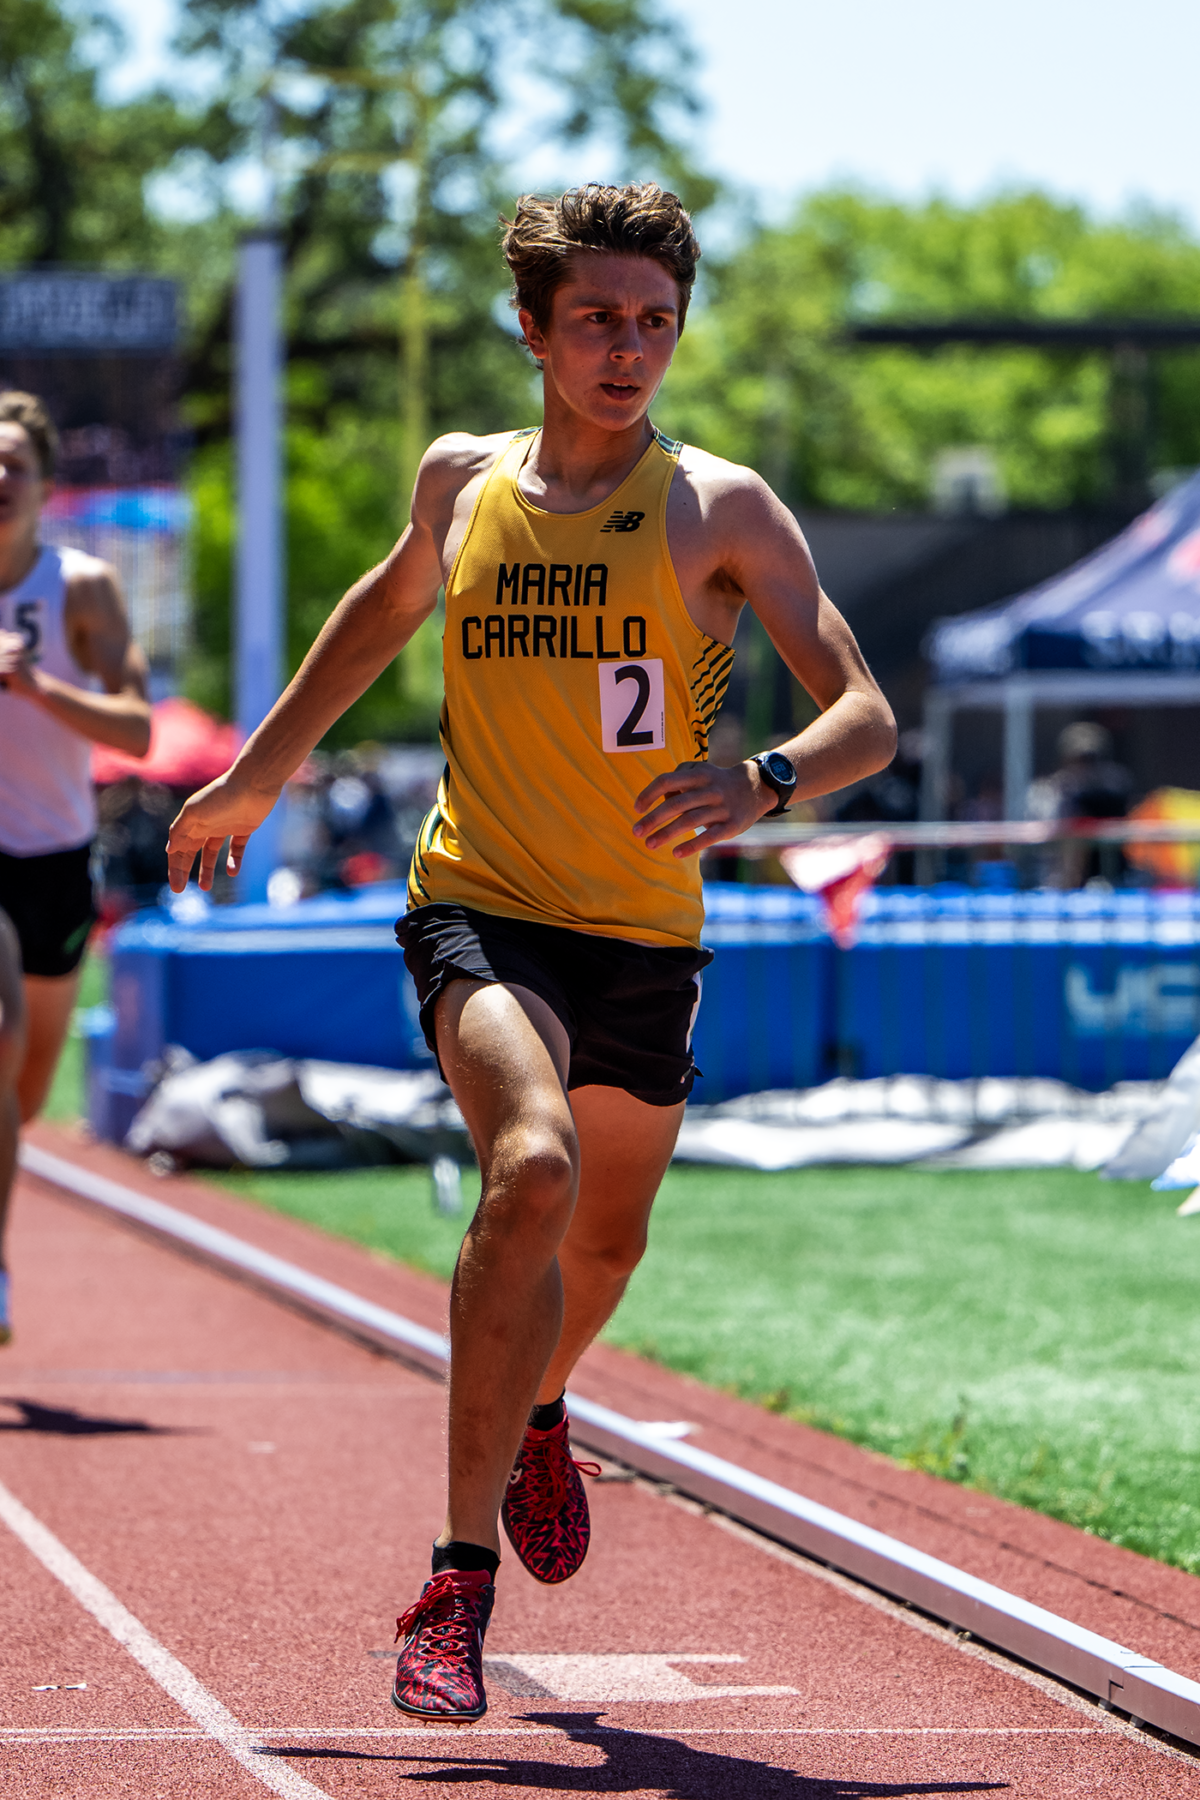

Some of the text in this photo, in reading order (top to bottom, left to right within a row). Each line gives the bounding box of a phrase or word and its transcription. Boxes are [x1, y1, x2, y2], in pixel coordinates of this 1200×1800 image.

[495, 563, 608, 606] MARIA
[461, 614, 647, 660] CARRILLO
[613, 664, 654, 748] 2
